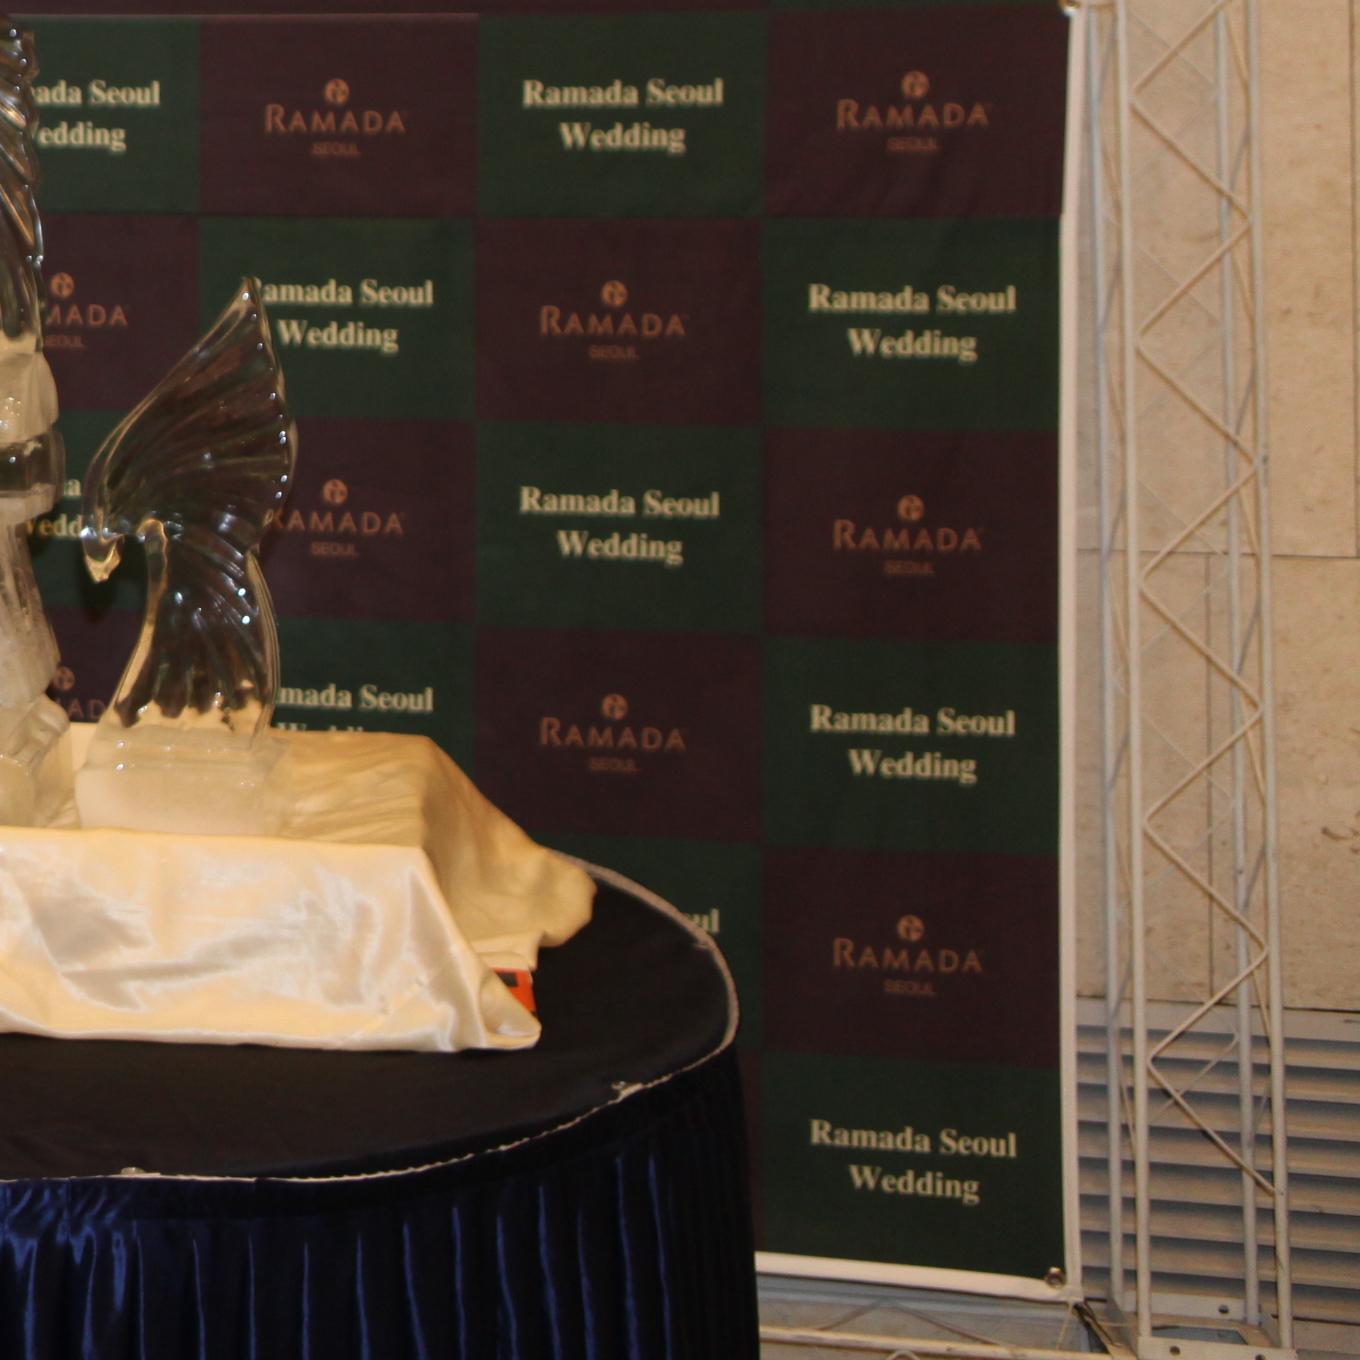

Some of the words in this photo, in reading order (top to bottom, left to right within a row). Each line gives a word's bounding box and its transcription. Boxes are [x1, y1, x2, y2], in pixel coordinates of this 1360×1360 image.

[90, 81, 160, 106] Seoul
[523, 80, 639, 107] Ramada
[647, 78, 723, 105] Seoul
[265, 104, 405, 134] RAMADA
[837, 99, 988, 129] RAMADA
[560, 123, 685, 153] Wedding
[361, 280, 433, 306] Seoul
[809, 284, 929, 312] Ramada
[938, 286, 1016, 312] Seoul
[278, 320, 398, 353] Wedding
[540, 305, 685, 337] RAMADA
[848, 328, 977, 362] Wedding
[520, 487, 635, 516] Ramada
[644, 491, 719, 517] Seoul
[558, 530, 683, 565] Wedding
[833, 519, 981, 551] RAMADA
[276, 683, 352, 708] mada
[360, 685, 433, 712] Seoul
[540, 717, 685, 750] RAMADA
[811, 705, 929, 734] Ramada
[938, 709, 1015, 736] Seoul
[849, 749, 977, 784] Wedding
[833, 937, 982, 973] RAMADA
[811, 1120, 931, 1153] Ramada
[940, 1130, 1016, 1158] Seoul
[850, 1165, 979, 1204] Wedding
